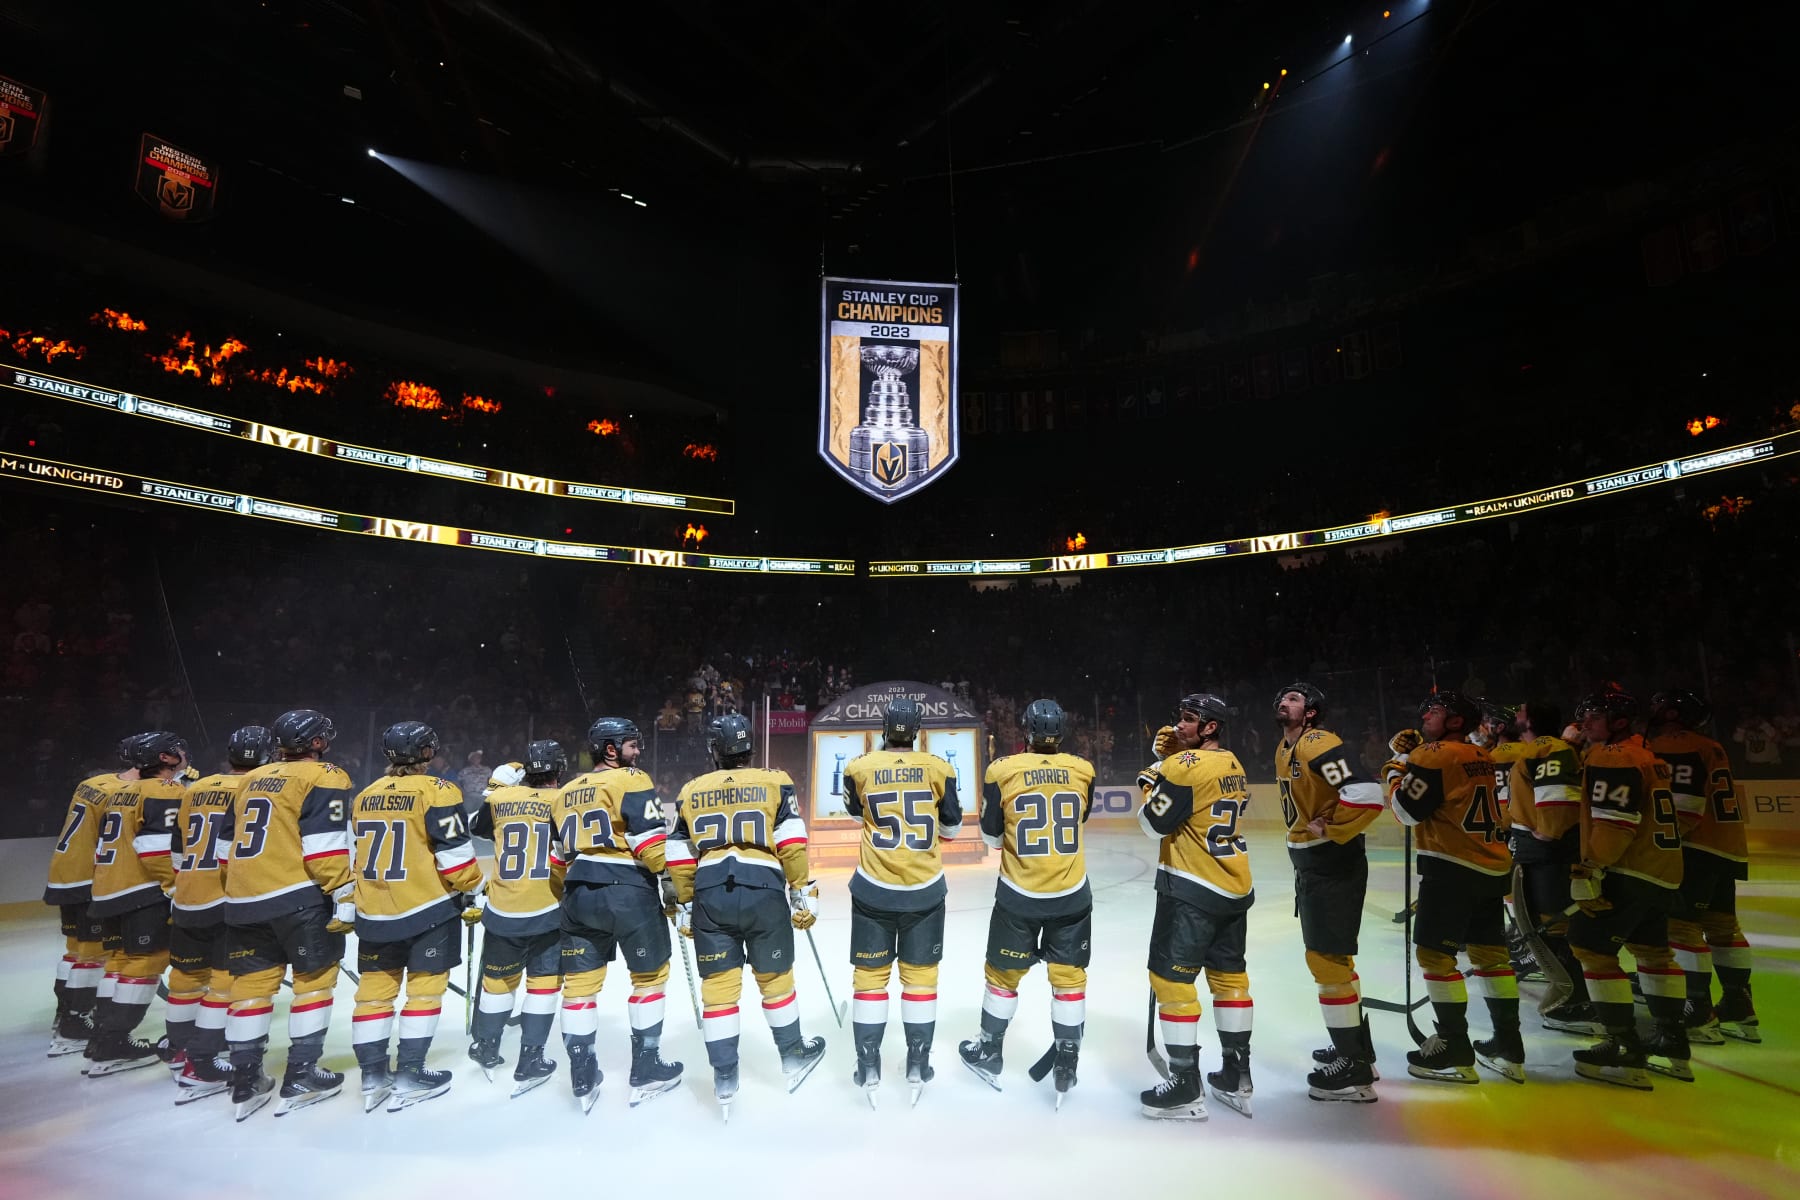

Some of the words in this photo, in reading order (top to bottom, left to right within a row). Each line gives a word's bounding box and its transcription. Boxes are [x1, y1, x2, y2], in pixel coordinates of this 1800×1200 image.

[153, 146, 208, 172] CONFERENCE
[161, 144, 202, 164] WESTERN
[149, 151, 209, 180] CHAMPIONS
[842, 290, 906, 304] STANLEY
[910, 294, 939, 306] CUP
[838, 302, 942, 324] CHAMPIONS
[870, 325, 910, 338] 2023
[29, 378, 90, 397] STANLEY
[91, 392, 118, 403] CUP
[138, 403, 214, 427] CHAMPIONS
[346, 450, 387, 463] STANLEY
[387, 456, 406, 466] CUP
[28, 463, 123, 489] UKNIGHTED
[1596, 473, 1640, 490] STANLEY
[1642, 468, 1663, 480] CUP
[154, 486, 209, 502] STANLEY
[211, 495, 235, 507] CUP
[575, 487, 607, 497] STANLEY
[607, 490, 622, 498] CUP
[1474, 502, 1508, 516] REALM
[1513, 488, 1574, 508] UKNIGHTED
[1331, 528, 1364, 540] STANLEY
[1365, 523, 1380, 533] CUP
[479, 537, 517, 548] STANLEY
[518, 542, 534, 550] CUP
[716, 558, 745, 567] STANLEY
[745, 560, 759, 568] CUP
[960, 563, 972, 571] CUP
[1123, 553, 1151, 562] STANLEY
[1151, 552, 1164, 560] CUP
[878, 564, 918, 573] UKNIGHTED
[845, 701, 948, 718] CHAONS
[736, 730, 746, 739] 20
[895, 724, 905, 732] 55
[244, 749, 254, 758] 21
[533, 760, 542, 768] 81
[874, 767, 924, 785] KOLESAR
[1023, 769, 1070, 786] CARRIER
[1291, 760, 1301, 778] C
[1321, 758, 1352, 786] 61
[1534, 759, 1561, 780] 36
[1668, 764, 1693, 785] 2
[360, 795, 416, 812] KARLSSON
[564, 786, 596, 809] COTTER
[691, 786, 767, 810] STEPHENSON
[1151, 781, 1173, 817] 3
[1592, 780, 1631, 807] 94
[164, 807, 179, 828] 2
[328, 800, 343, 822] 3
[866, 790, 935, 851] 55
[55, 803, 87, 854] 7
[234, 797, 273, 859] 3
[438, 812, 465, 840] 71
[558, 807, 617, 855] 43
[693, 809, 768, 850] 20
[1013, 792, 1081, 857] 28
[94, 811, 123, 865] 2
[180, 811, 226, 872] 21
[356, 819, 408, 882] 71
[499, 821, 550, 881] 81
[228, 948, 256, 960] CCM
[561, 948, 585, 956] CCM
[698, 951, 728, 962] CCM
[999, 948, 1031, 959] CCM
